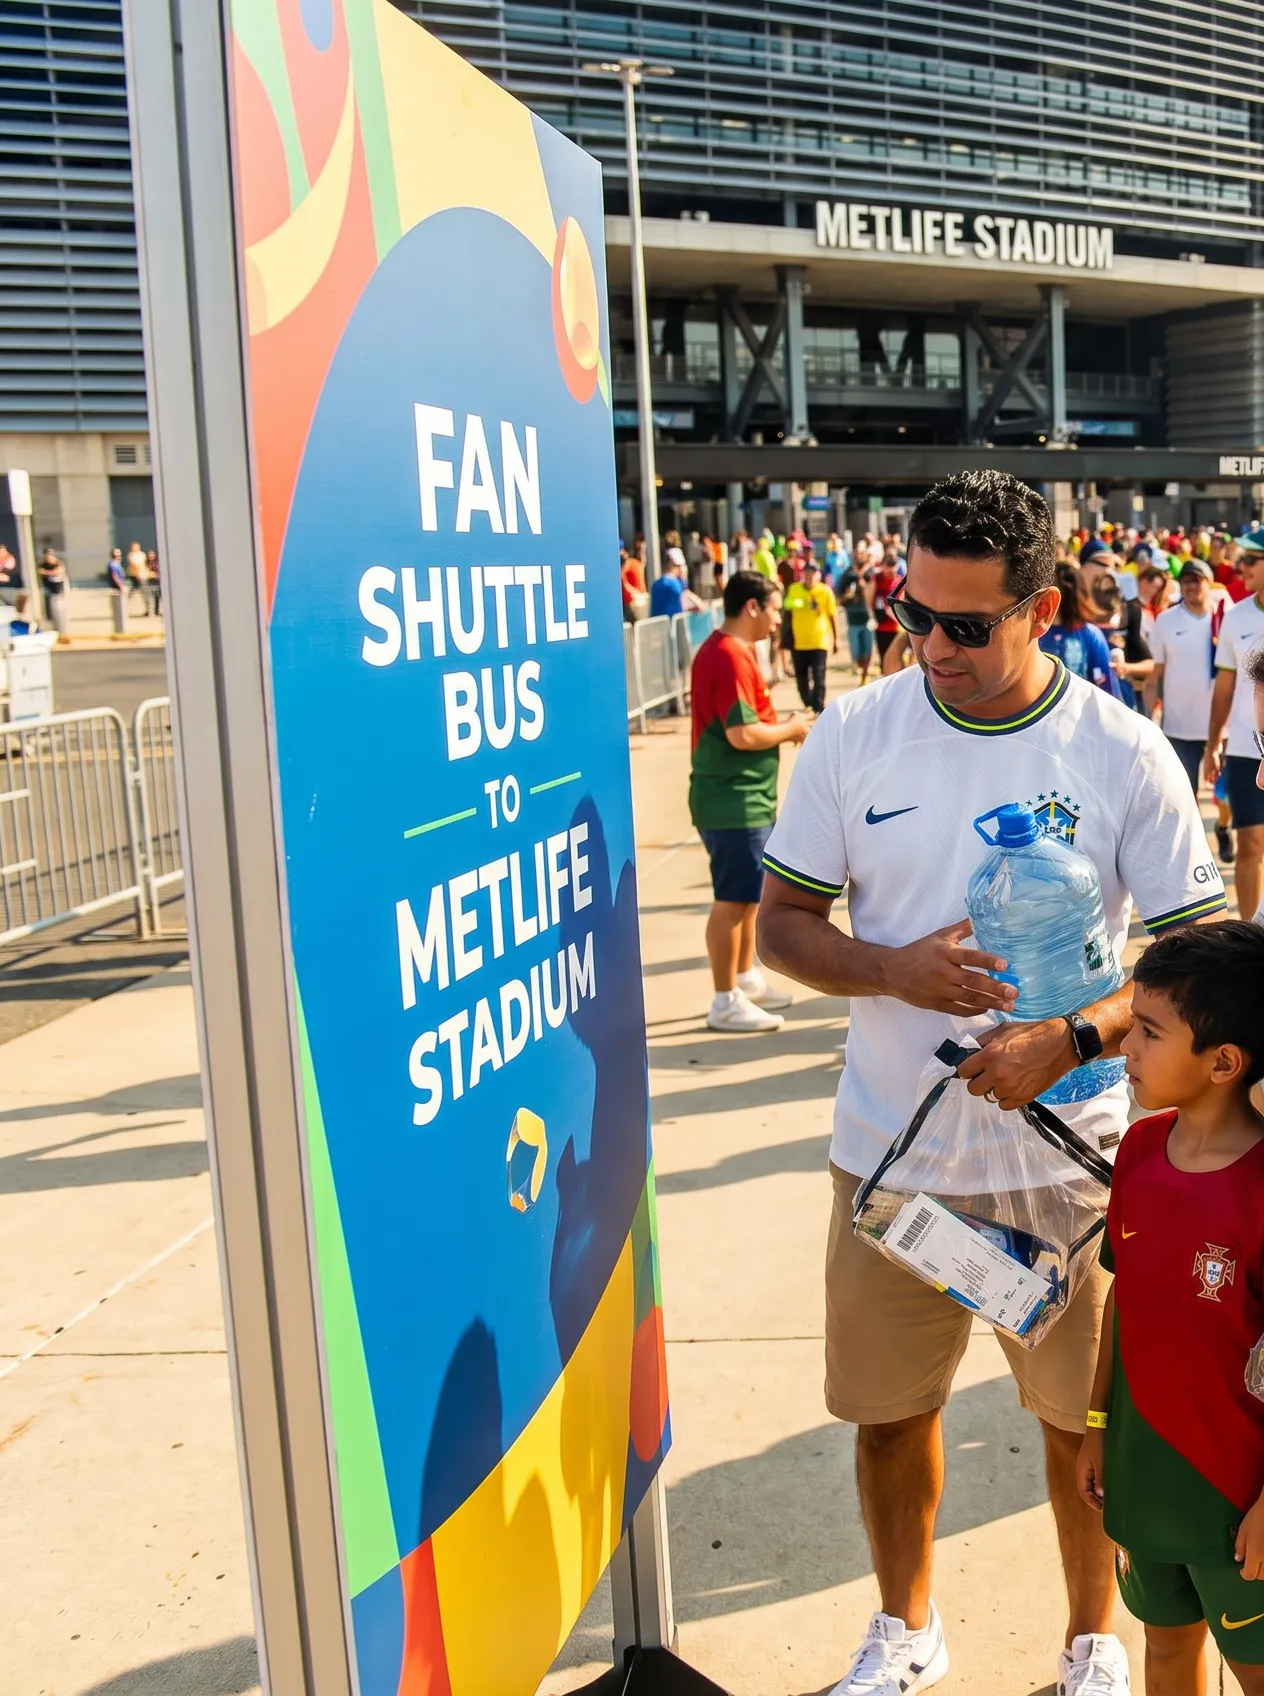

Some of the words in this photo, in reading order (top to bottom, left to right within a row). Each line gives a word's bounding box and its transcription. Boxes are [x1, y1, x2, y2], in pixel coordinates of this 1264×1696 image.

[815, 200, 964, 255] METLIFE
[973, 215, 1114, 269] STADIUM
[414, 403, 542, 535] FAN
[358, 565, 589, 667] SHUTTLE
[443, 660, 545, 762] BUS
[484, 774, 521, 829] TO
[396, 822, 592, 1011] METLIFE
[408, 931, 596, 1126] STADIUM
